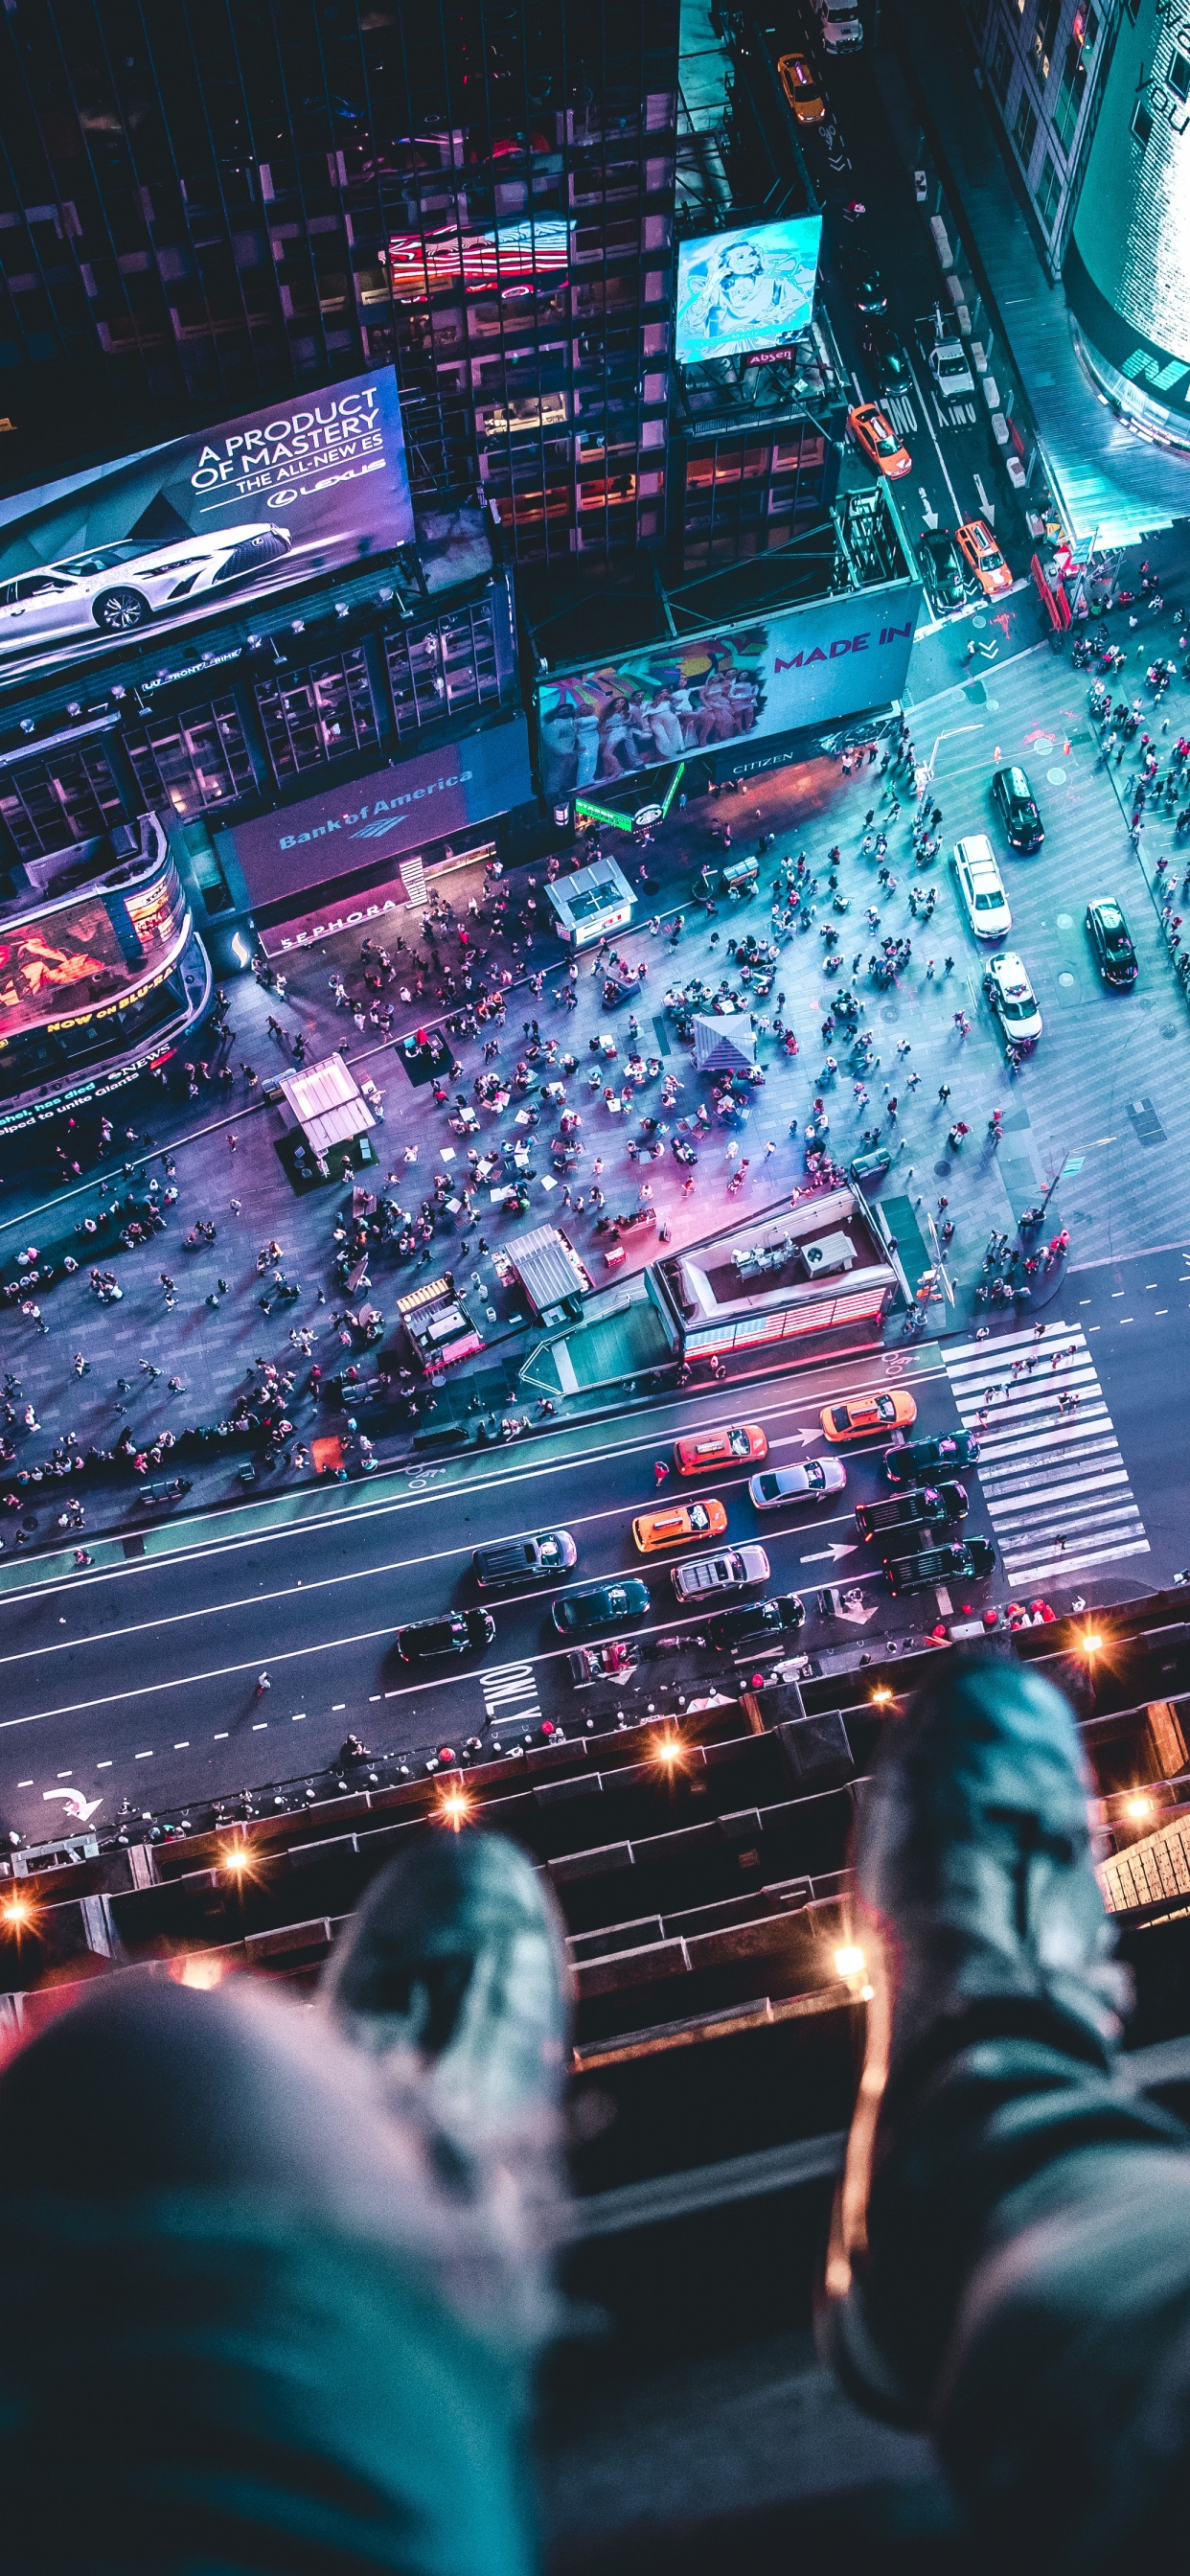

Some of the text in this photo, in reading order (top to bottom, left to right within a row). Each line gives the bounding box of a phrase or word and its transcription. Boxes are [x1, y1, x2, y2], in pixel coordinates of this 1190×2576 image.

[750, 351, 792, 364] Absen
[191, 408, 379, 489] OF MASTERY
[198, 387, 378, 467] A PRODUCT
[237, 433, 383, 494] THE ALL-NEW ES
[300, 458, 386, 495] LEXUS
[774, 621, 912, 674] MADE IN
[732, 751, 794, 774] CITIZEN
[279, 770, 473, 850] Bank of America
[281, 899, 397, 950] SEPHORA
[47, 1014, 93, 1033] NOW
[96, 1005, 116, 1019] ON
[121, 1043, 171, 1076] NEWS
[34, 1096, 61, 1112] has
[64, 1082, 97, 1100] died
[38, 1112, 55, 1120] to
[57, 1094, 92, 1114] unite
[95, 1072, 140, 1096] Giants
[479, 1666, 542, 1725] ONLY
